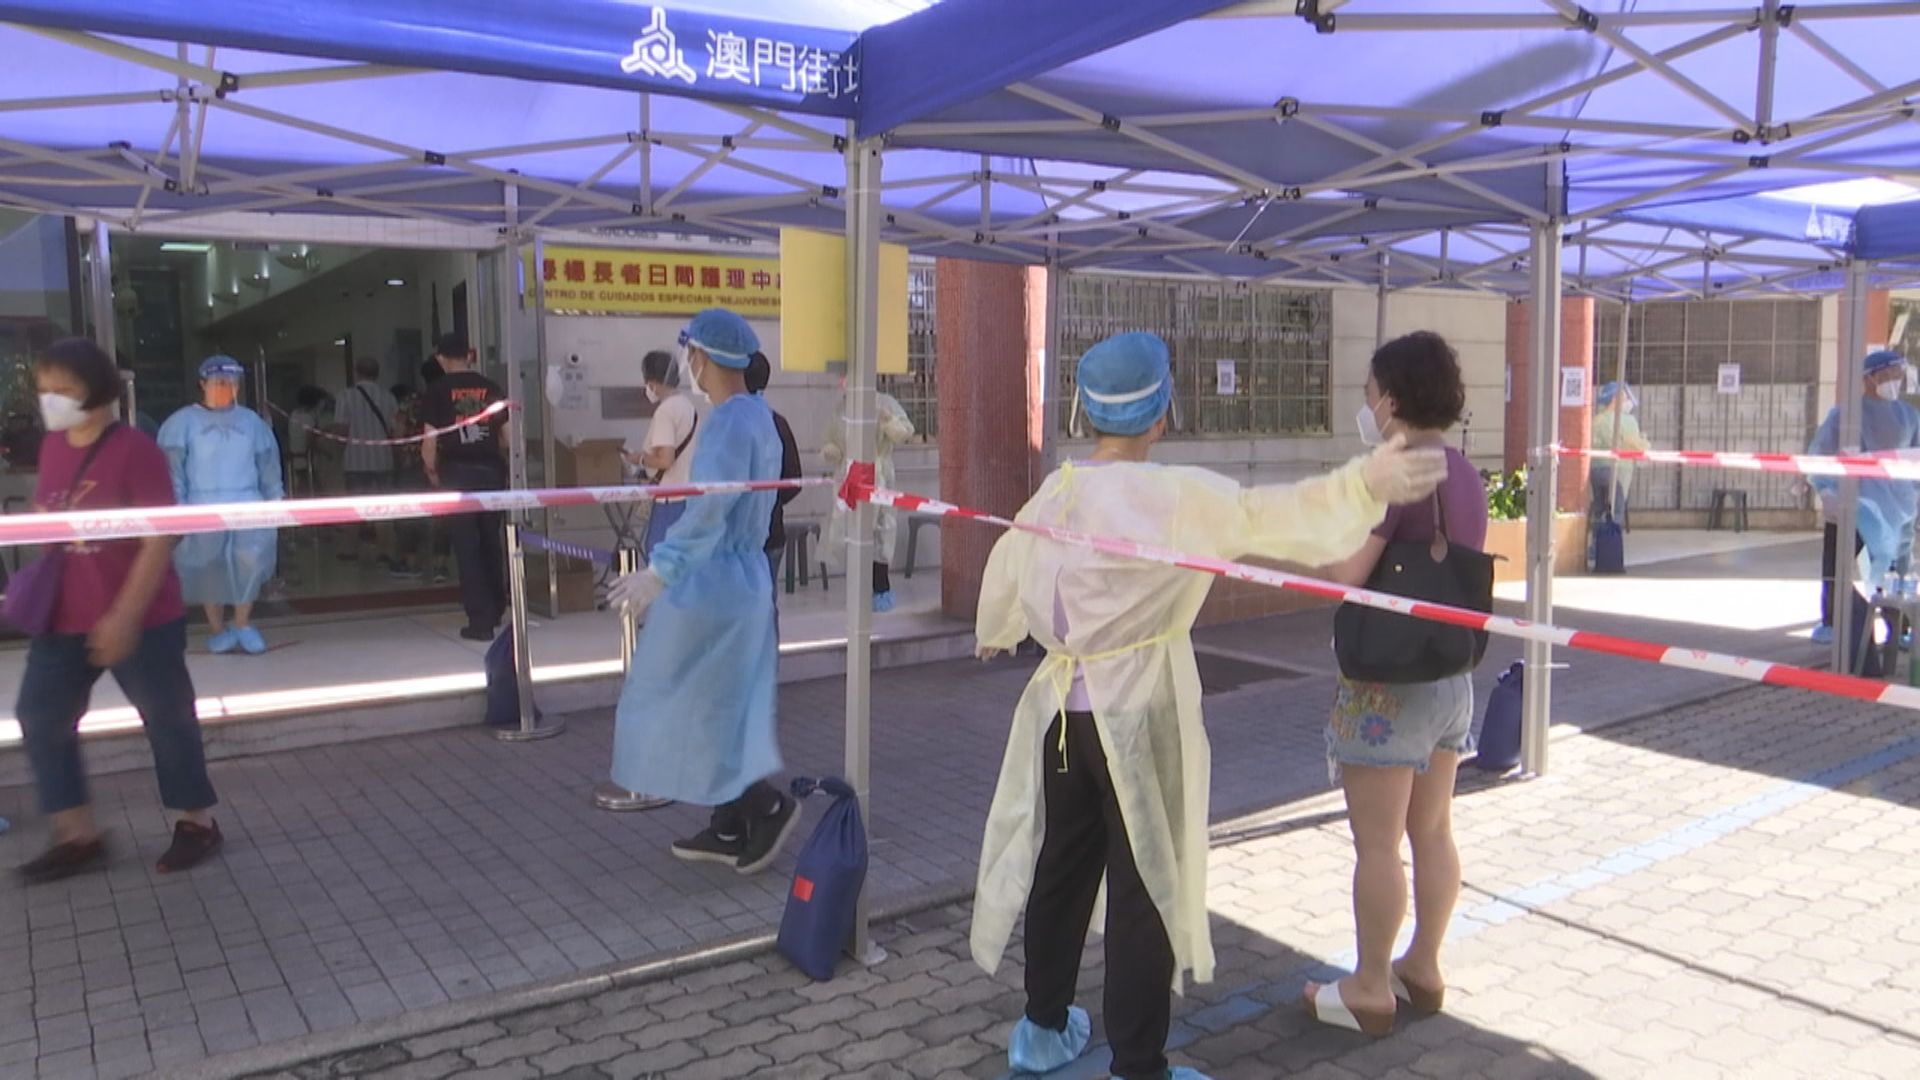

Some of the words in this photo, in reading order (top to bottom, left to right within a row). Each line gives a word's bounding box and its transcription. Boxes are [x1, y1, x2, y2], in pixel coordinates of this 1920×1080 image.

[528, 288, 577, 300] CNTRO
[580, 289, 595, 301] DE
[599, 290, 655, 303] CUIDADOS
[658, 292, 713, 305] ESPECIAIS
